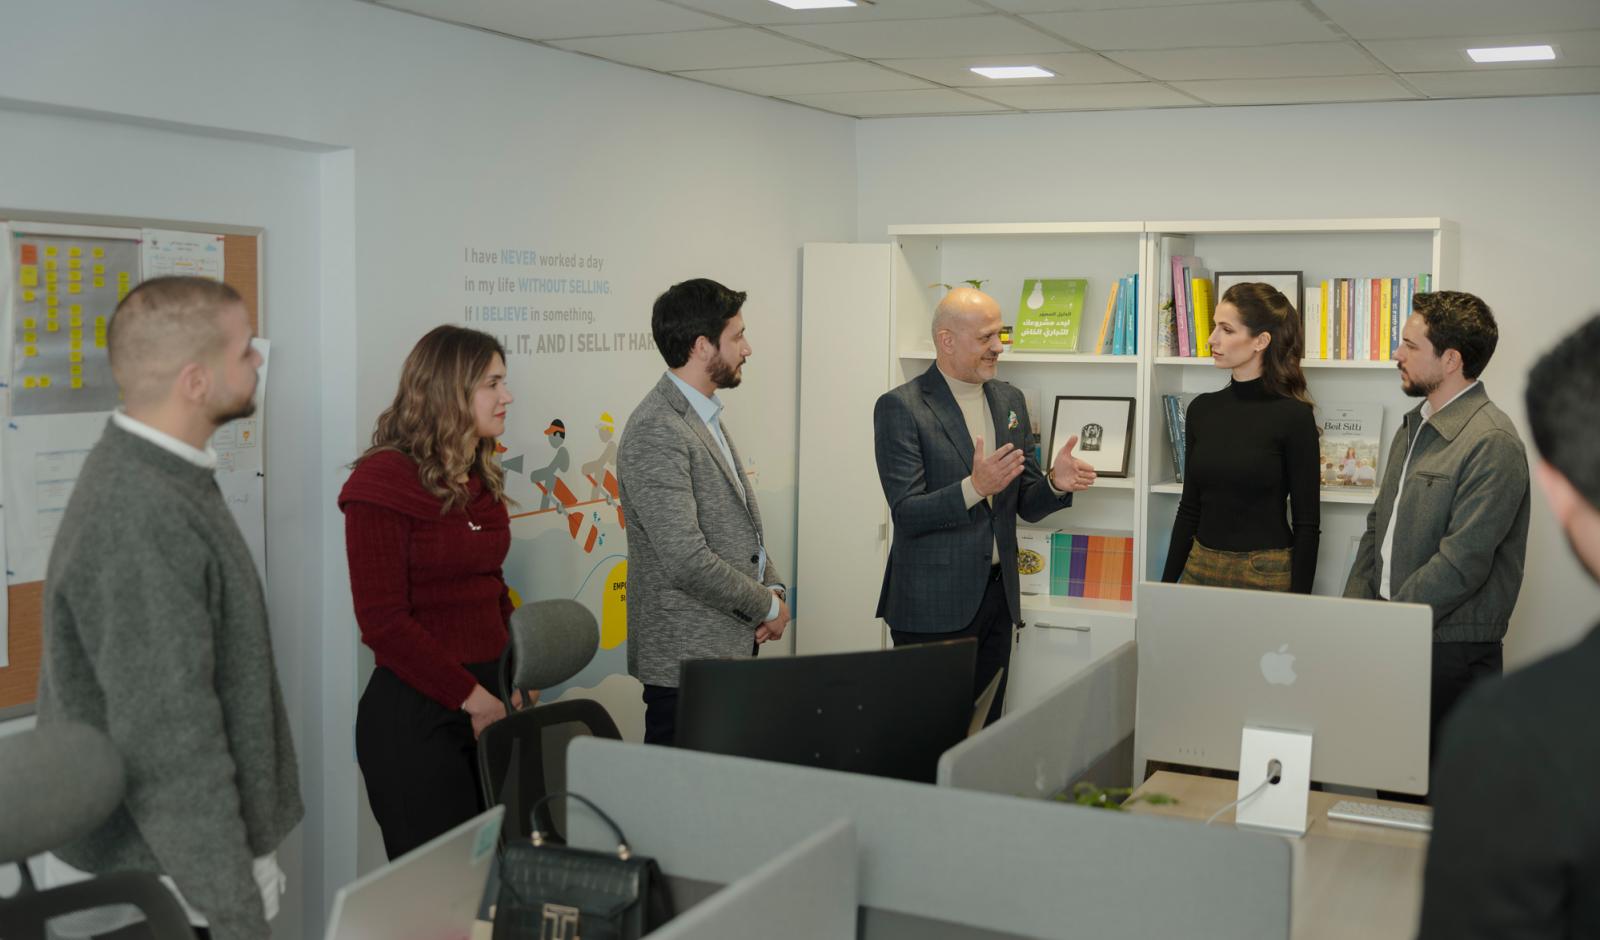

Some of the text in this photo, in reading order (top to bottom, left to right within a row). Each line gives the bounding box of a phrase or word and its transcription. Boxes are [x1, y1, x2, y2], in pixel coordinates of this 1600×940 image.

[464, 247, 604, 273] I have NEVER worked a day
[464, 275, 475, 292] in
[478, 279, 496, 296] my
[498, 276, 515, 293] life
[518, 277, 567, 294] WITHOUT
[464, 305, 473, 322] If
[475, 305, 480, 321] I
[482, 305, 528, 321] BELIEVE
[530, 306, 540, 321] in
[516, 333, 532, 356] IT,
[535, 333, 566, 354] AND
[569, 333, 574, 353] I
[577, 333, 610, 352] SELL
[613, 333, 625, 351] IT
[629, 332, 658, 351] HAR
